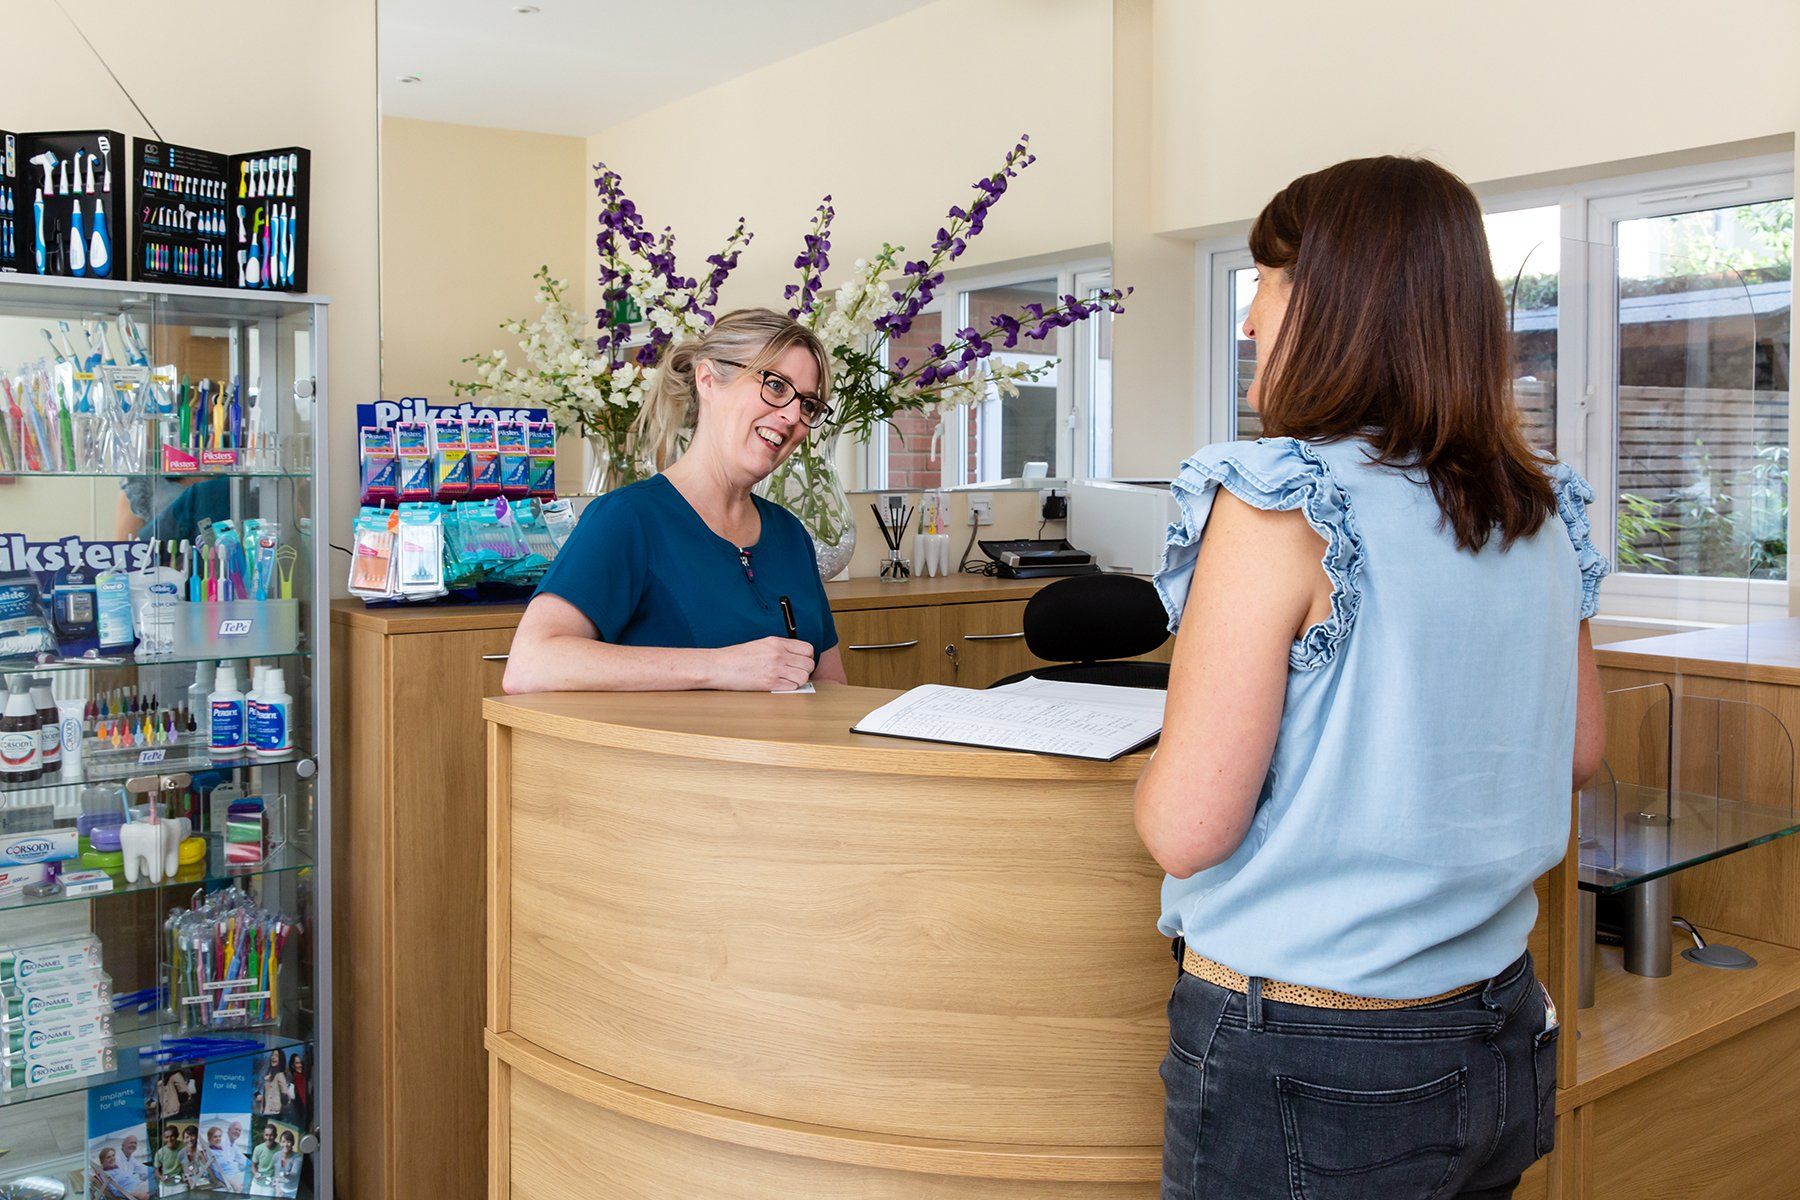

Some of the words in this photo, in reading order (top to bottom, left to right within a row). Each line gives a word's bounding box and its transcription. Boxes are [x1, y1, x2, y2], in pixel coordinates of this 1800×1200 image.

[0, 536, 153, 571] iksters
[0, 591, 27, 600] lide
[224, 622, 248, 632] TePe
[6, 842, 55, 855] CORSODYL
[226, 1082, 237, 1090] life
[99, 1102, 111, 1111] for
[113, 1099, 126, 1108] life
